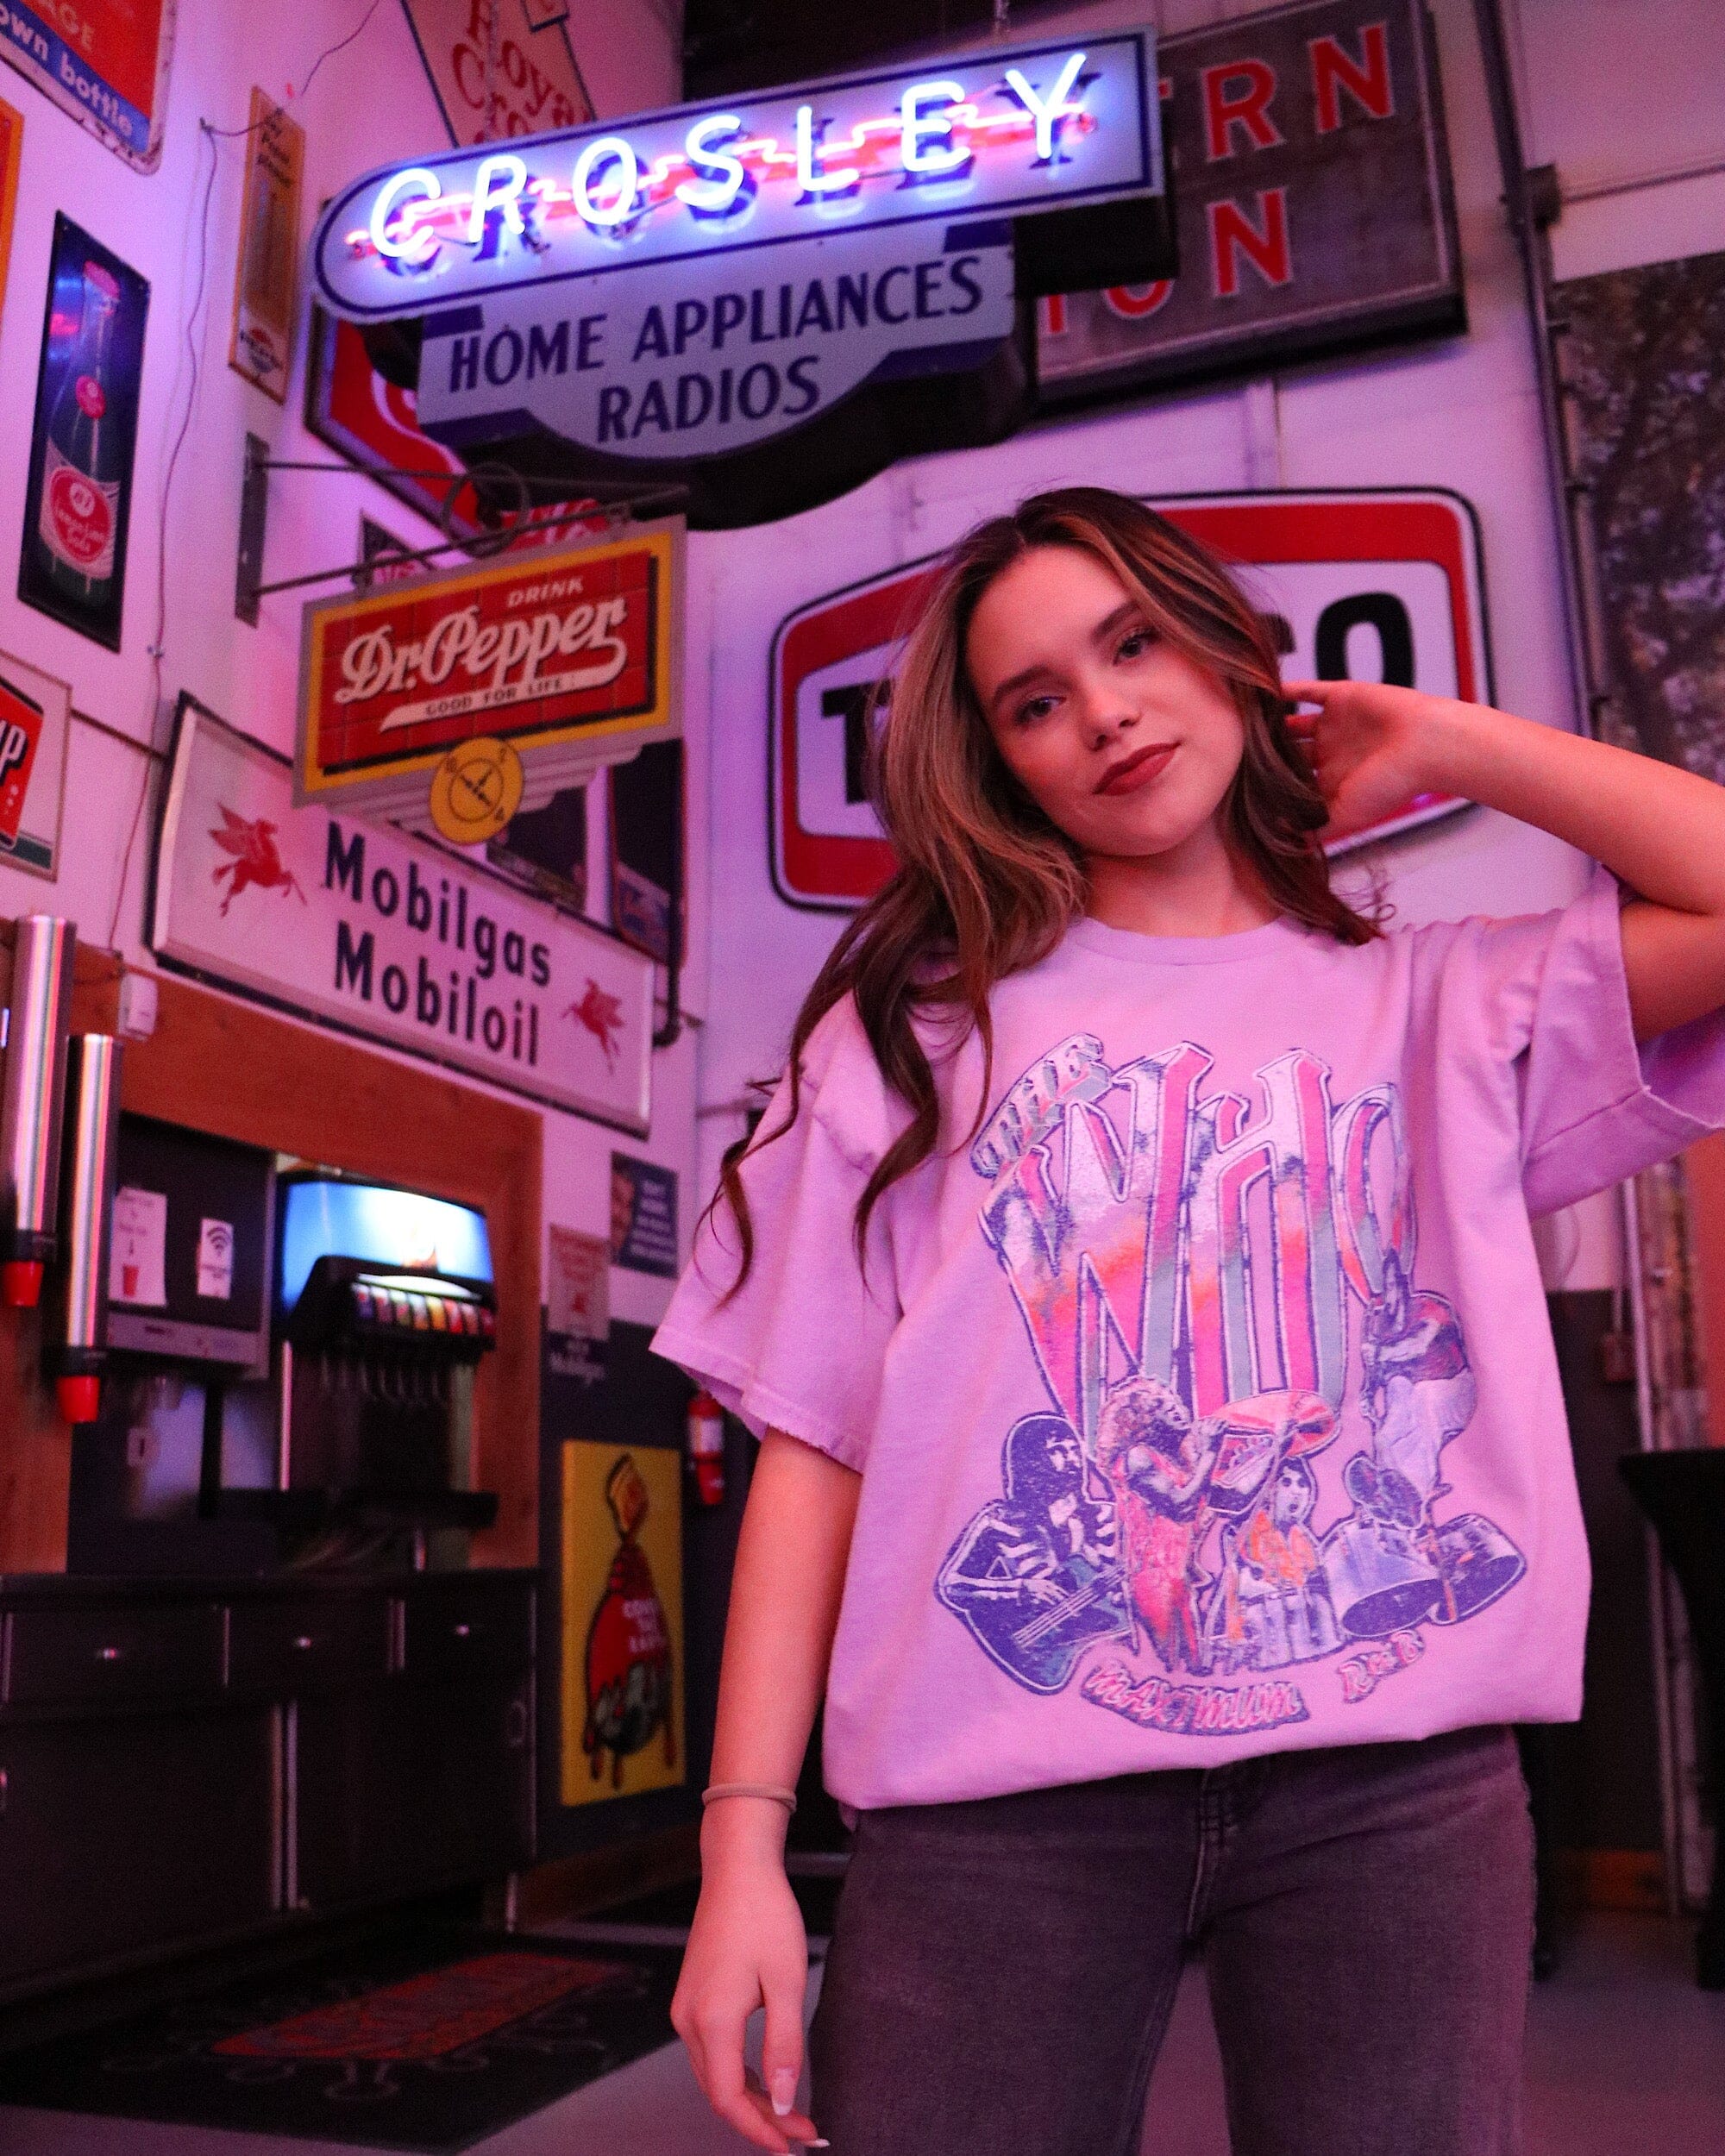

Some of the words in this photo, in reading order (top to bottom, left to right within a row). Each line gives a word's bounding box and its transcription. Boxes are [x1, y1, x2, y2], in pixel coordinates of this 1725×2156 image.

[60, 52, 133, 137] bottle
[369, 52, 1092, 263] CROSLEY
[448, 314, 607, 394] HOME
[631, 257, 983, 364] APPLIANCES
[595, 354, 822, 443] RADIOS
[506, 576, 585, 609] DRINK
[425, 694, 474, 718] GOOD
[483, 687, 517, 705] FOR
[527, 676, 563, 698] LIFE
[324, 820, 552, 987] Mobilgas
[334, 919, 540, 1067] Mobiloil
[969, 1031, 1113, 1180] THE
[977, 1039, 1419, 1492] WHO
